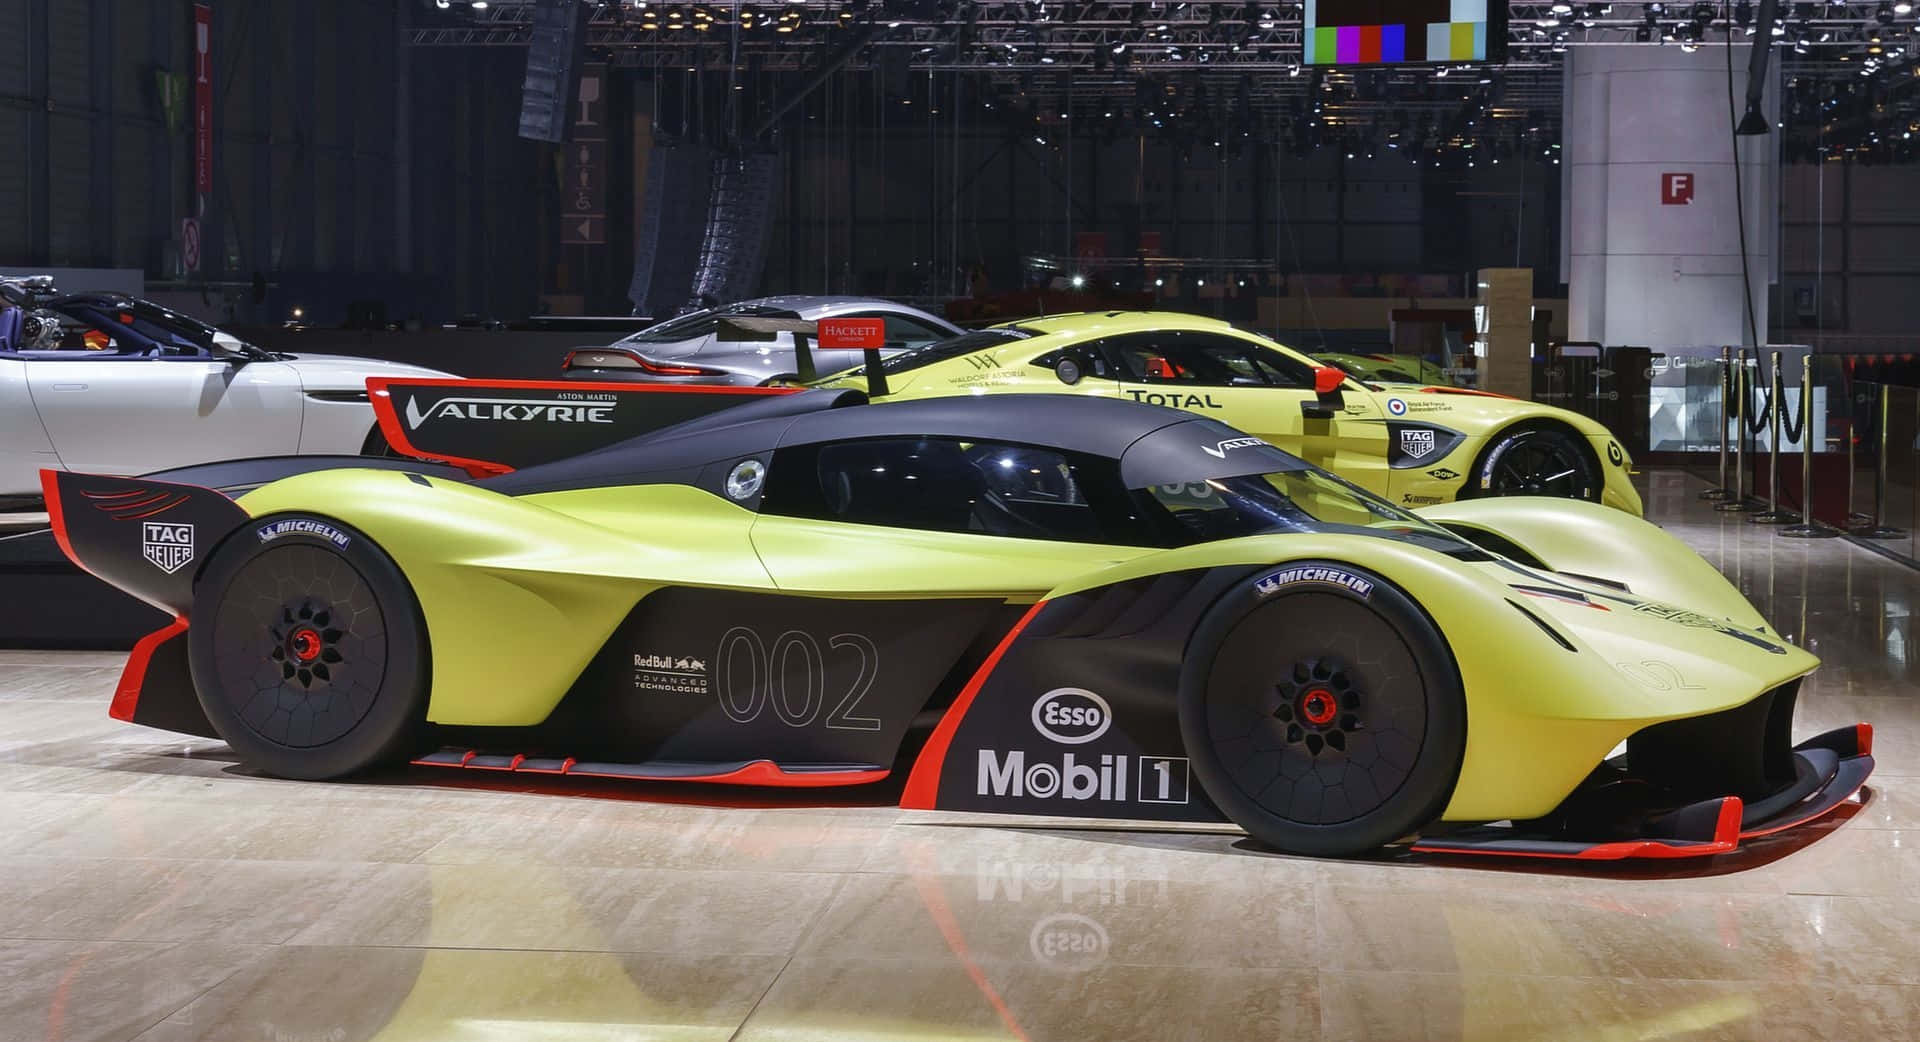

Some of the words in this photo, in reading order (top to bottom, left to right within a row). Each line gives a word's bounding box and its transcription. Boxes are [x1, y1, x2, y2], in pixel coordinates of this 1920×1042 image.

[1671, 175, 1688, 198] F
[824, 325, 878, 336] HACKETT
[557, 392, 584, 401] ASTON
[586, 393, 618, 401] MARTIN
[1126, 390, 1223, 409] TOTAL
[406, 394, 618, 430] VALKYRIE
[1405, 432, 1431, 441] TAG
[1403, 442, 1432, 456] HEUER
[147, 526, 189, 542] TAG
[277, 521, 348, 545] MICHELIN
[146, 544, 191, 570] HEUER
[1279, 569, 1369, 593] MICHELIN
[634, 674, 708, 686] ADVANCED
[634, 682, 708, 694] TECHNOLOGIES
[716, 626, 881, 731] 002
[1045, 701, 1100, 727] Esso
[977, 749, 1128, 801] Mobil
